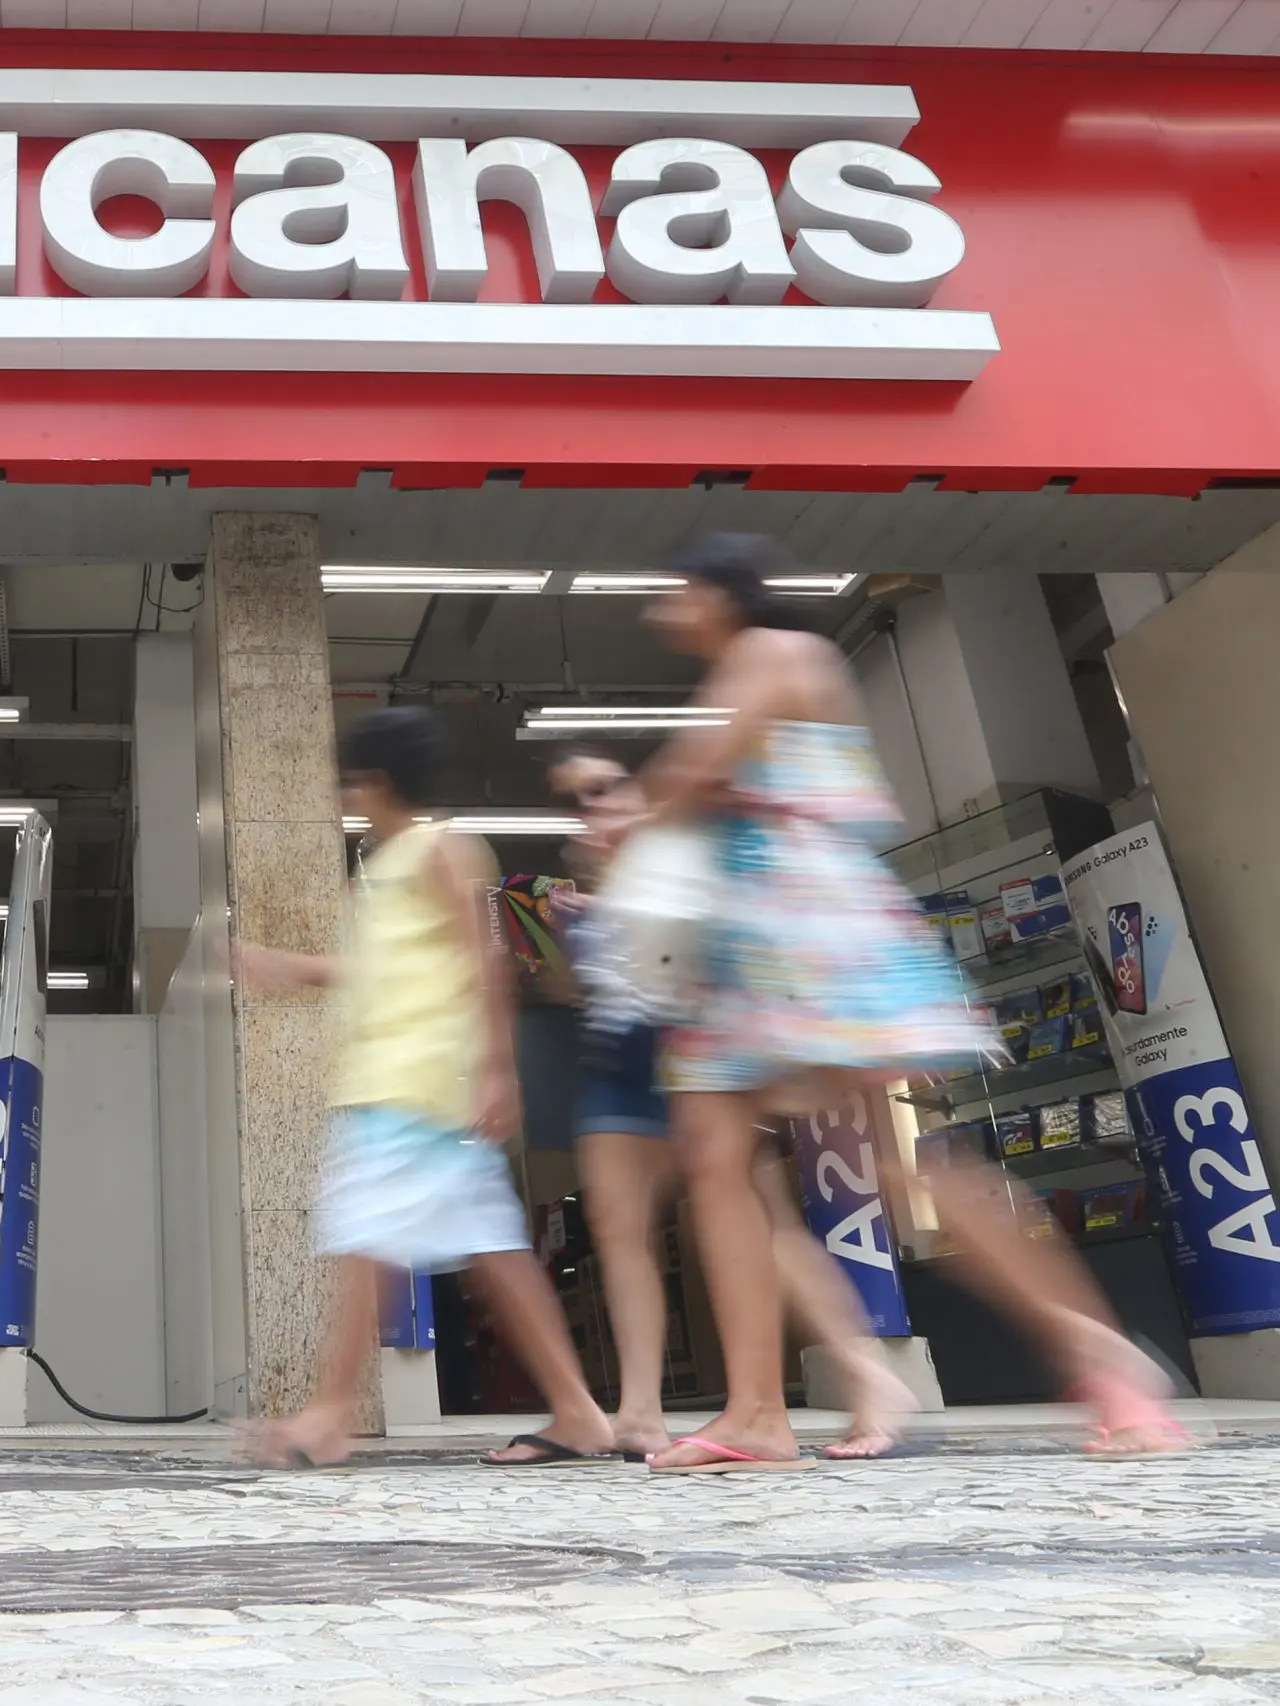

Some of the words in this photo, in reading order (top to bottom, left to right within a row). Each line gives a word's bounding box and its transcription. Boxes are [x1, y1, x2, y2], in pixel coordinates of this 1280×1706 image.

[1093, 840, 1128, 867] Galaxy
[1128, 836, 1150, 853] A23
[1135, 1047, 1168, 1067] Galaxy
[809, 1089, 893, 1272] A23
[1173, 1086, 1280, 1263] A23
